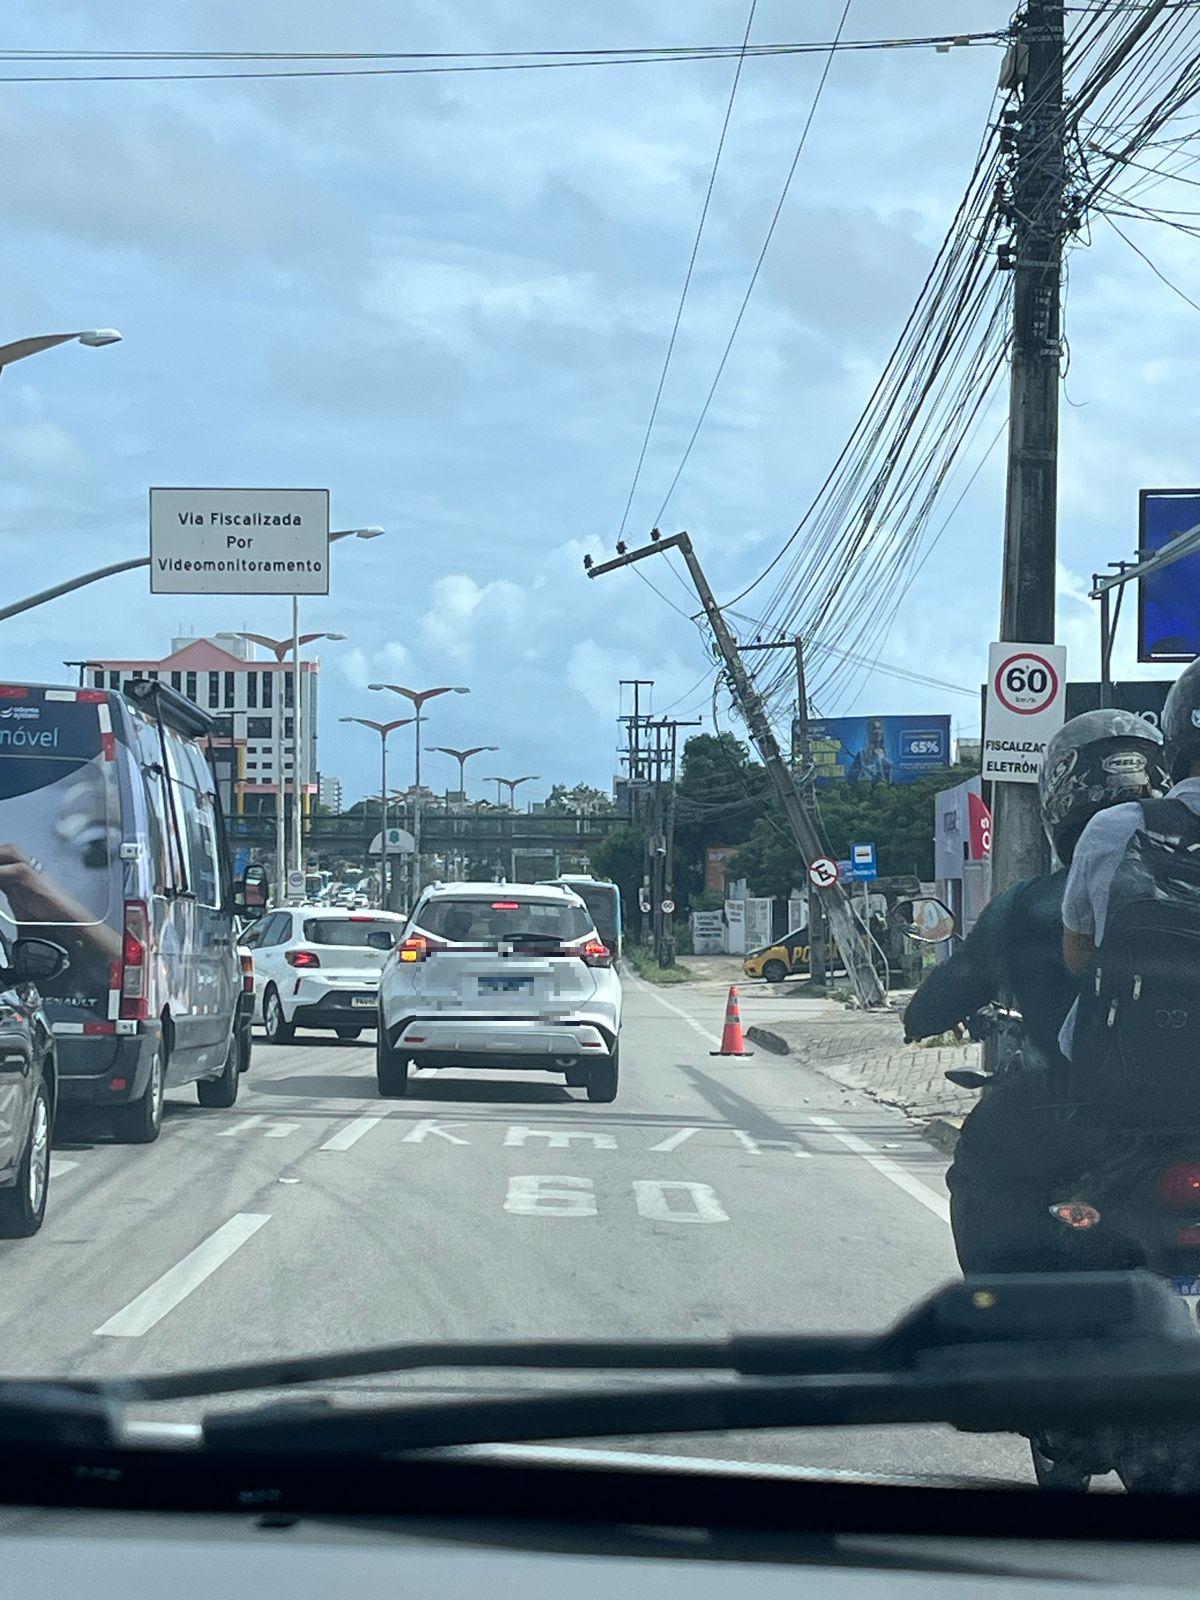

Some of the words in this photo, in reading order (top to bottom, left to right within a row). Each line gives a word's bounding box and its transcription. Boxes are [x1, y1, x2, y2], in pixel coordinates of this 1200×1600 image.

[178, 512, 204, 526] Via
[210, 512, 302, 526] Fiscalizada
[227, 535, 253, 548] Por
[158, 558, 322, 572] Videomonitoramento
[1007, 667, 1047, 693] 60
[911, 741, 939, 754] 65%
[503, 1175, 731, 1223] 60
